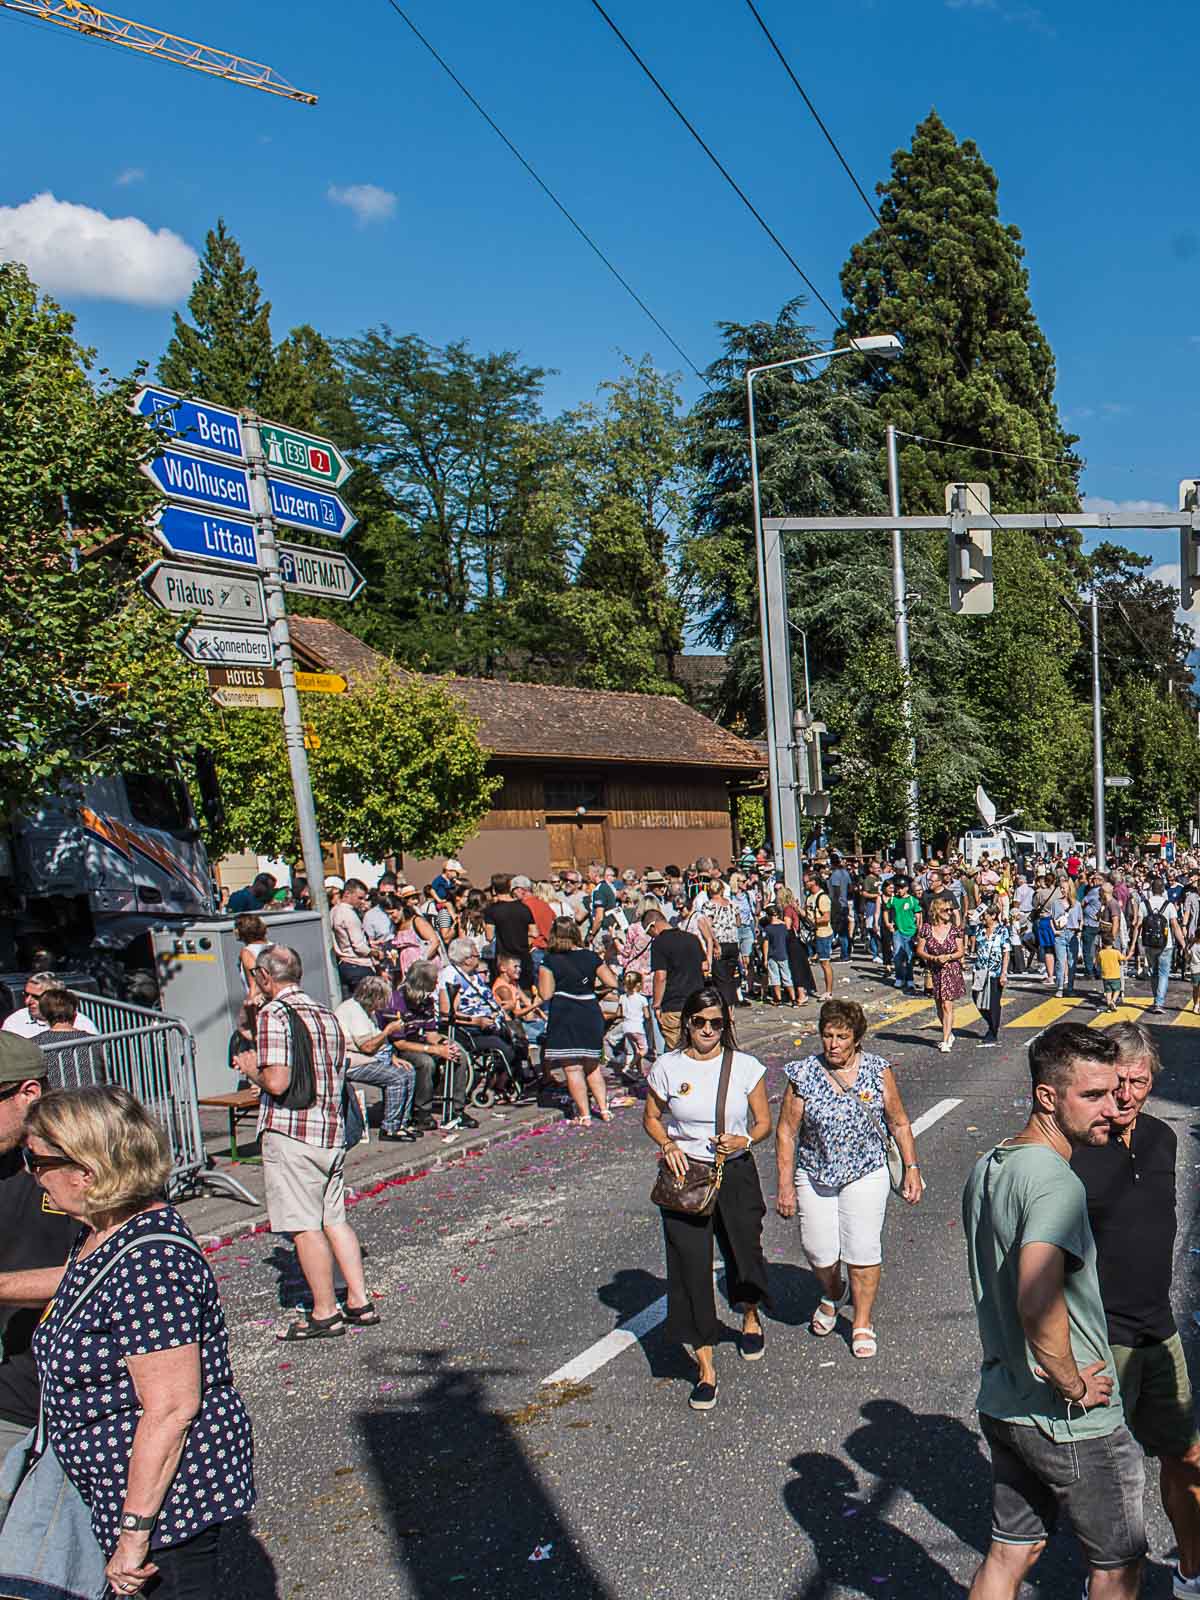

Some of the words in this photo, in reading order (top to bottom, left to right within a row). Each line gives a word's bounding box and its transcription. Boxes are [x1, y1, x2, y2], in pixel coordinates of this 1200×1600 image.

[197, 411, 239, 449] Bern
[287, 443, 305, 464] E35
[317, 452, 324, 470] 2
[163, 456, 247, 503] Wolhusen
[271, 485, 319, 522] Luzern
[322, 503, 335, 522] 2a
[203, 521, 254, 558] Littau
[284, 559, 292, 581] P
[295, 556, 346, 591] HOFMATT
[166, 576, 215, 606] Pilatus
[213, 637, 267, 659] Sonnenberg
[225, 669, 265, 686] HOTELS
[224, 688, 259, 706] Sonnenberg
